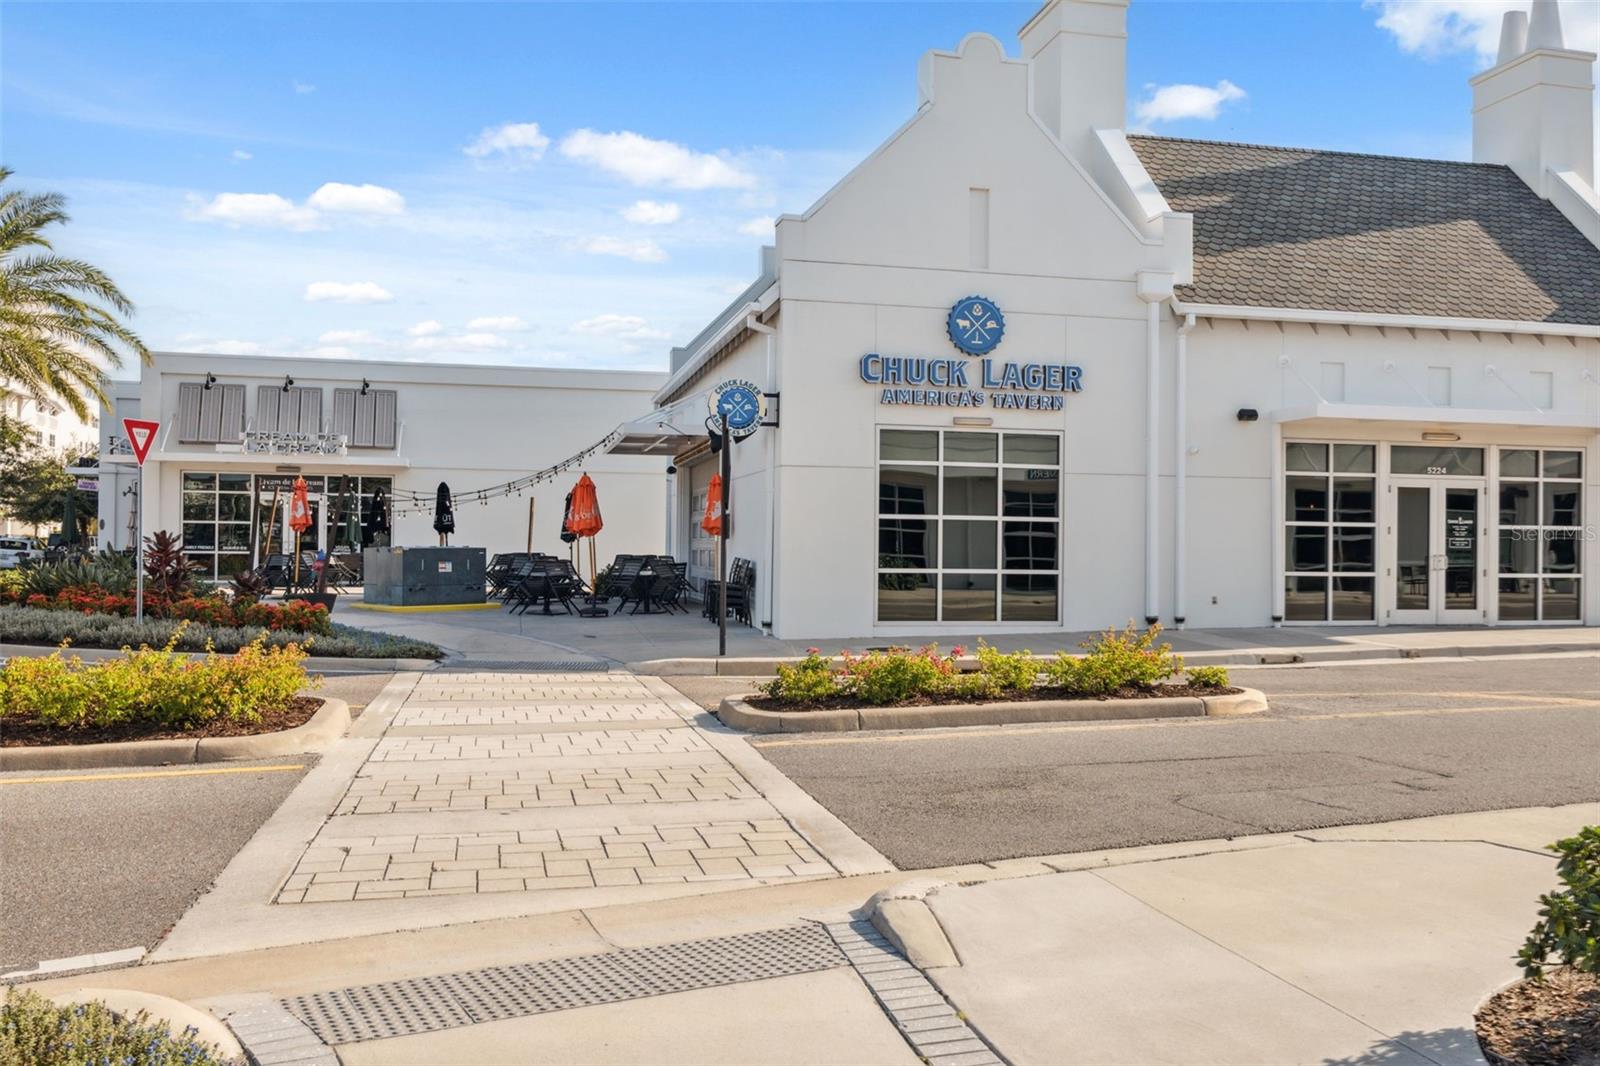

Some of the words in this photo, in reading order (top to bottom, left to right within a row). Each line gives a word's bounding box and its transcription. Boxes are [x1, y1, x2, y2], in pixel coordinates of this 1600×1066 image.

[860, 353, 968, 387] CHUCK
[981, 358, 1084, 392] LAGER
[715, 380, 738, 395] CHUCK
[740, 380, 761, 396] LAGER
[881, 388, 985, 408] AMERICA'S
[992, 393, 1065, 411] TAVERN
[1427, 466, 1447, 474] 5224
